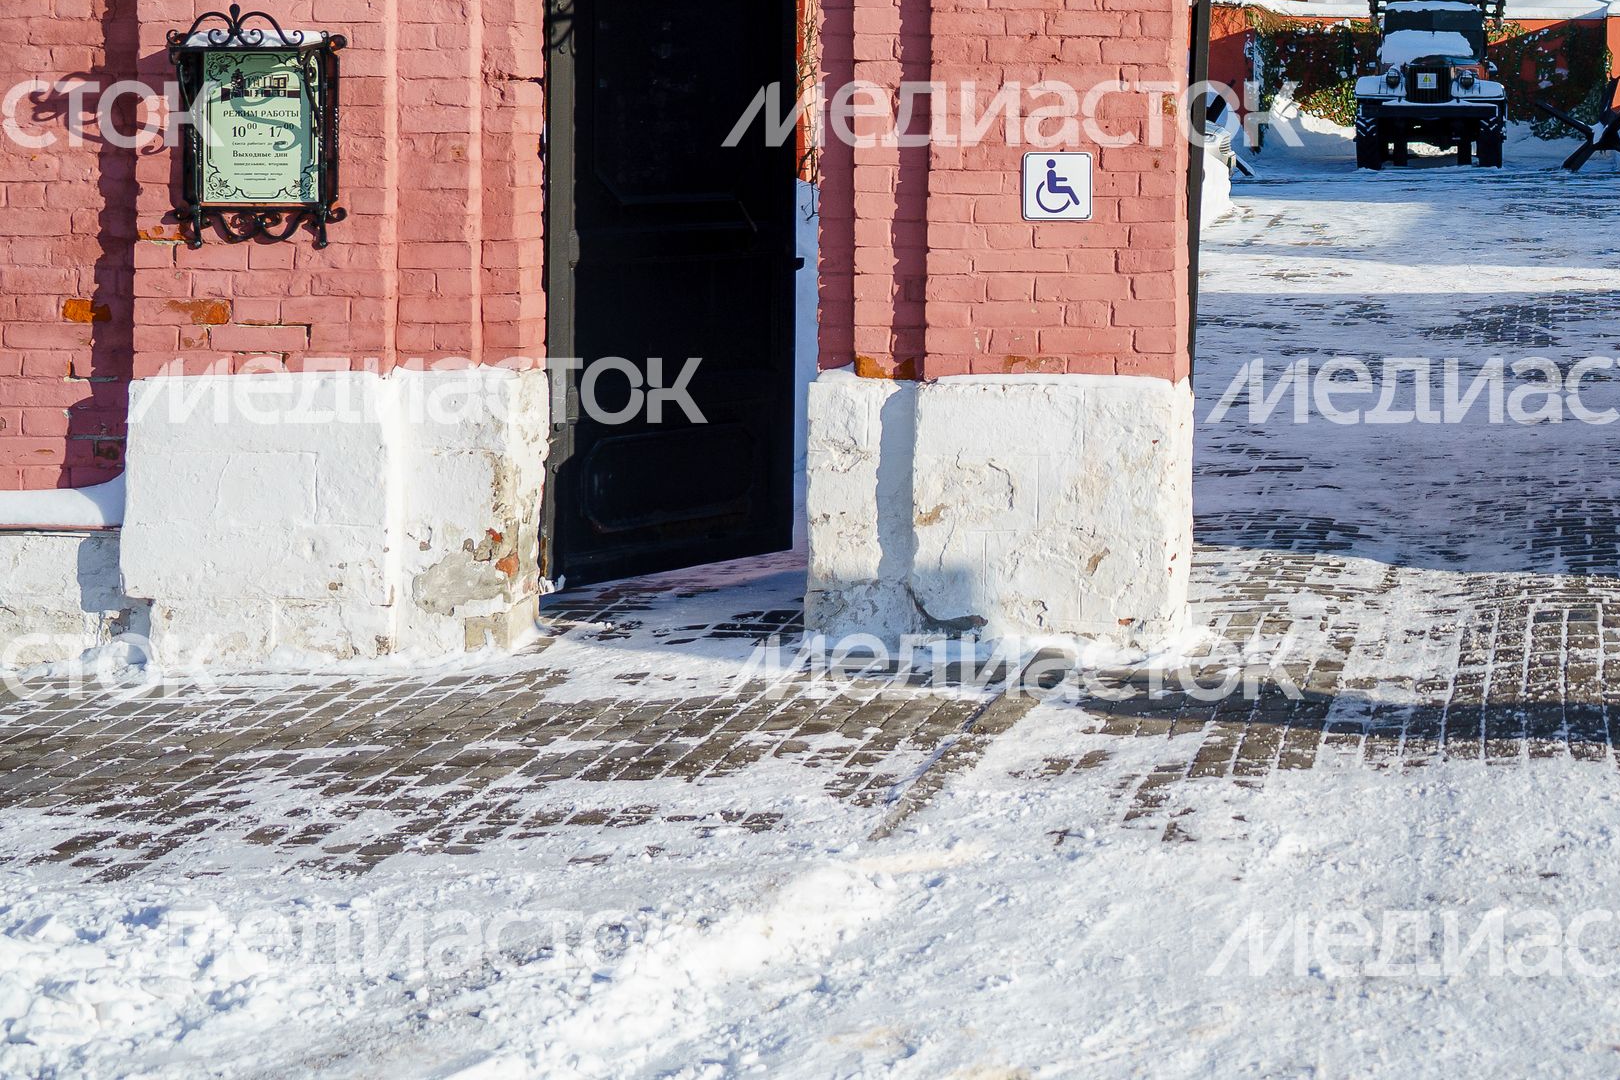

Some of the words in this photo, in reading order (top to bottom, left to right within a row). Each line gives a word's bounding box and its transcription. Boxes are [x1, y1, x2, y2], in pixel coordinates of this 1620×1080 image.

[223, 110, 258, 118] РЕЖИМ
[261, 110, 299, 118] РАБОТЫ
[233, 150, 271, 158] Выходные
